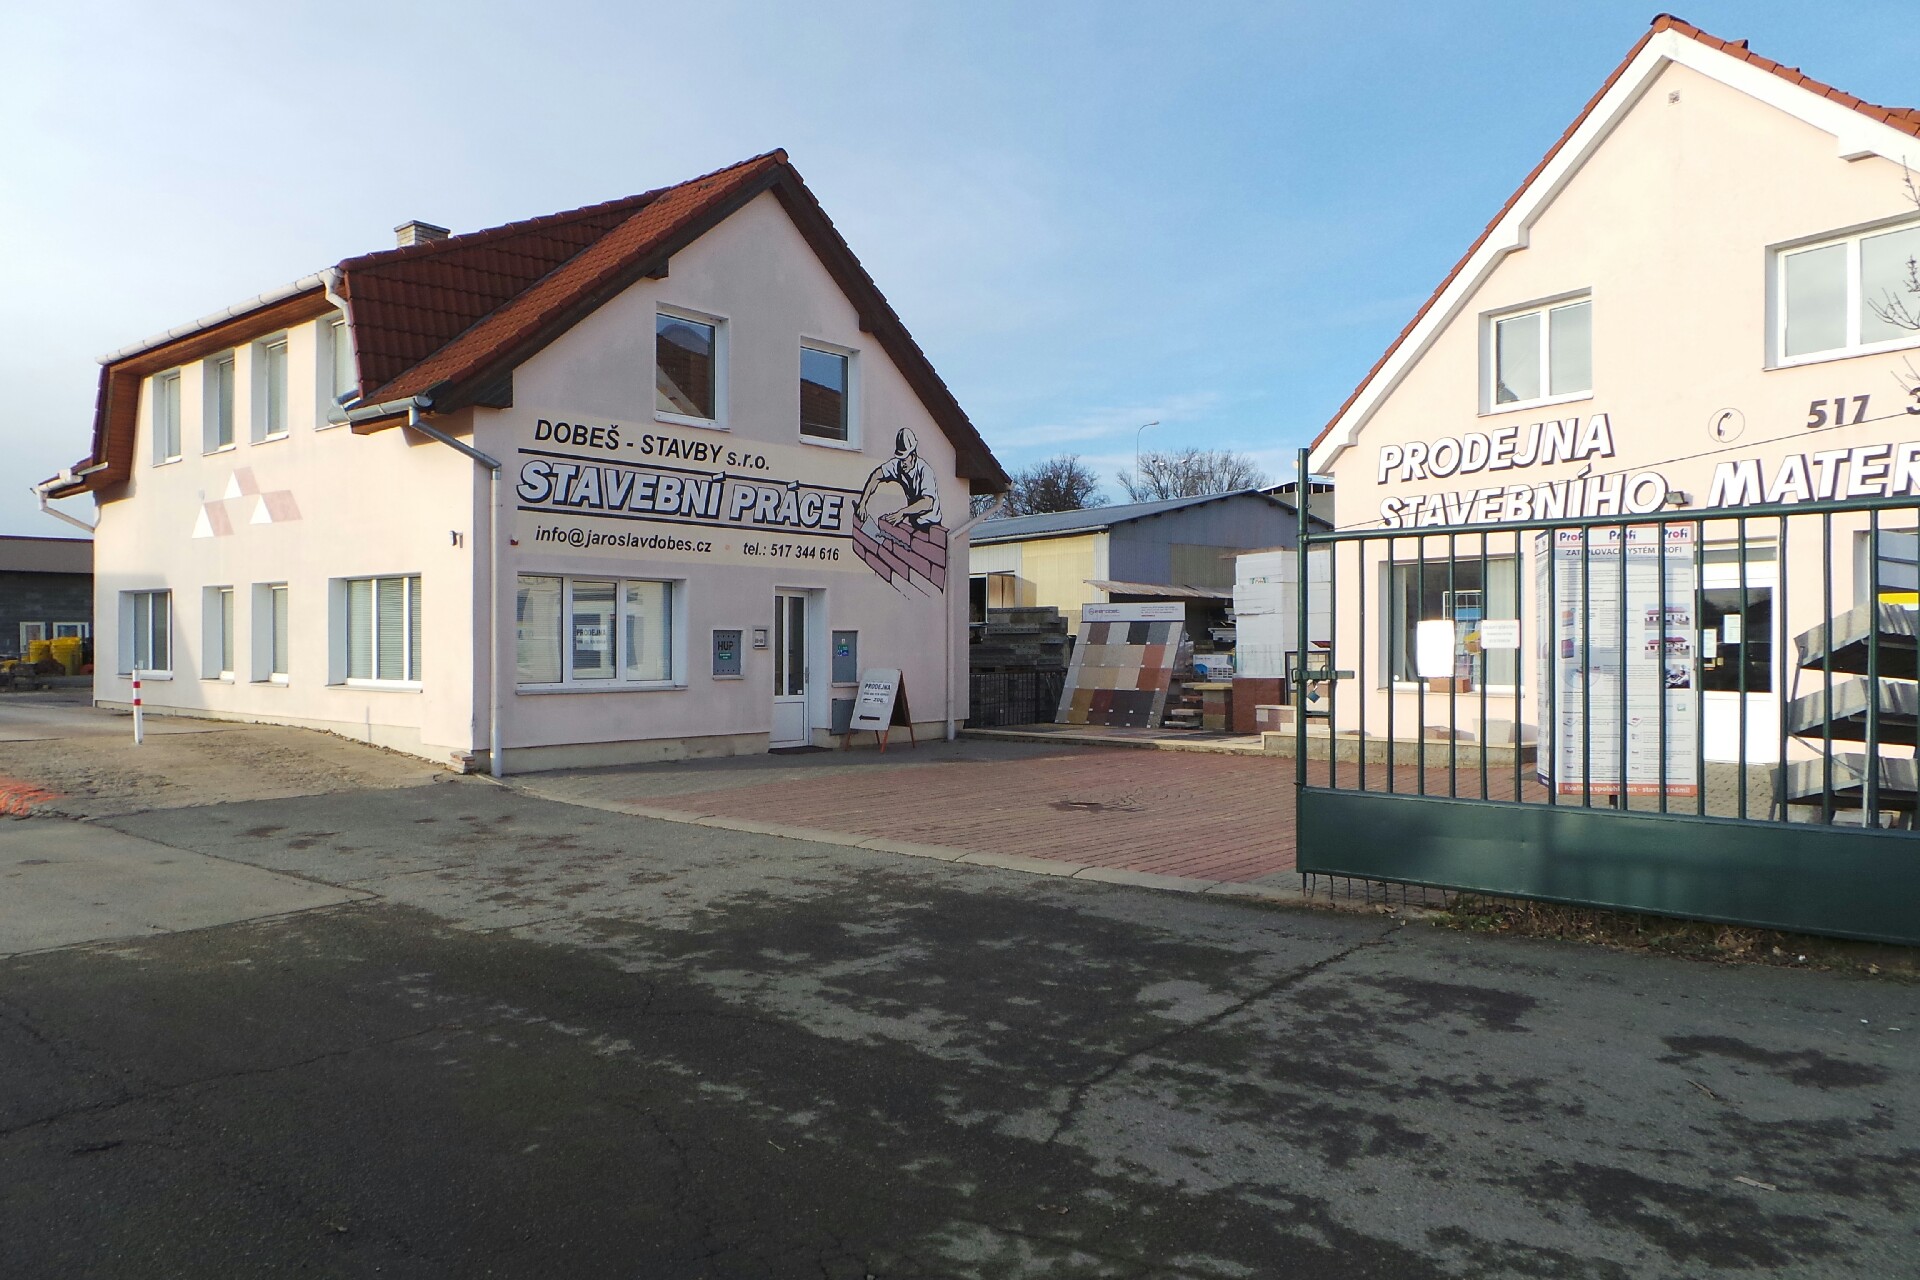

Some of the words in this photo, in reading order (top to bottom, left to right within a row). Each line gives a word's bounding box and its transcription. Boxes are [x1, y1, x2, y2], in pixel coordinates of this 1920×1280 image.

[1806, 394, 1871, 428] 517
[535, 419, 620, 450] DOBEŠ
[640, 434, 724, 465] STAVBY
[726, 451, 770, 470] s.r.o.
[1377, 413, 1615, 485] PRODEJNA
[516, 459, 727, 520] STAVEBNÍ
[729, 480, 845, 531] PRÁCE
[1377, 463, 1669, 529] STAVEBNÍHO
[535, 525, 712, 553] info@jaroslavdobes.cz
[743, 542, 766, 556] tel.:
[770, 543, 793, 558] 517
[795, 545, 816, 560] 344
[819, 548, 840, 561] 616
[1559, 531, 1584, 541] Prof
[1609, 530, 1636, 540] Prfi
[1566, 548, 1621, 556] ZATLOVAC
[717, 640, 734, 651] HUP
[1594, 785, 1638, 793] spolehlost
